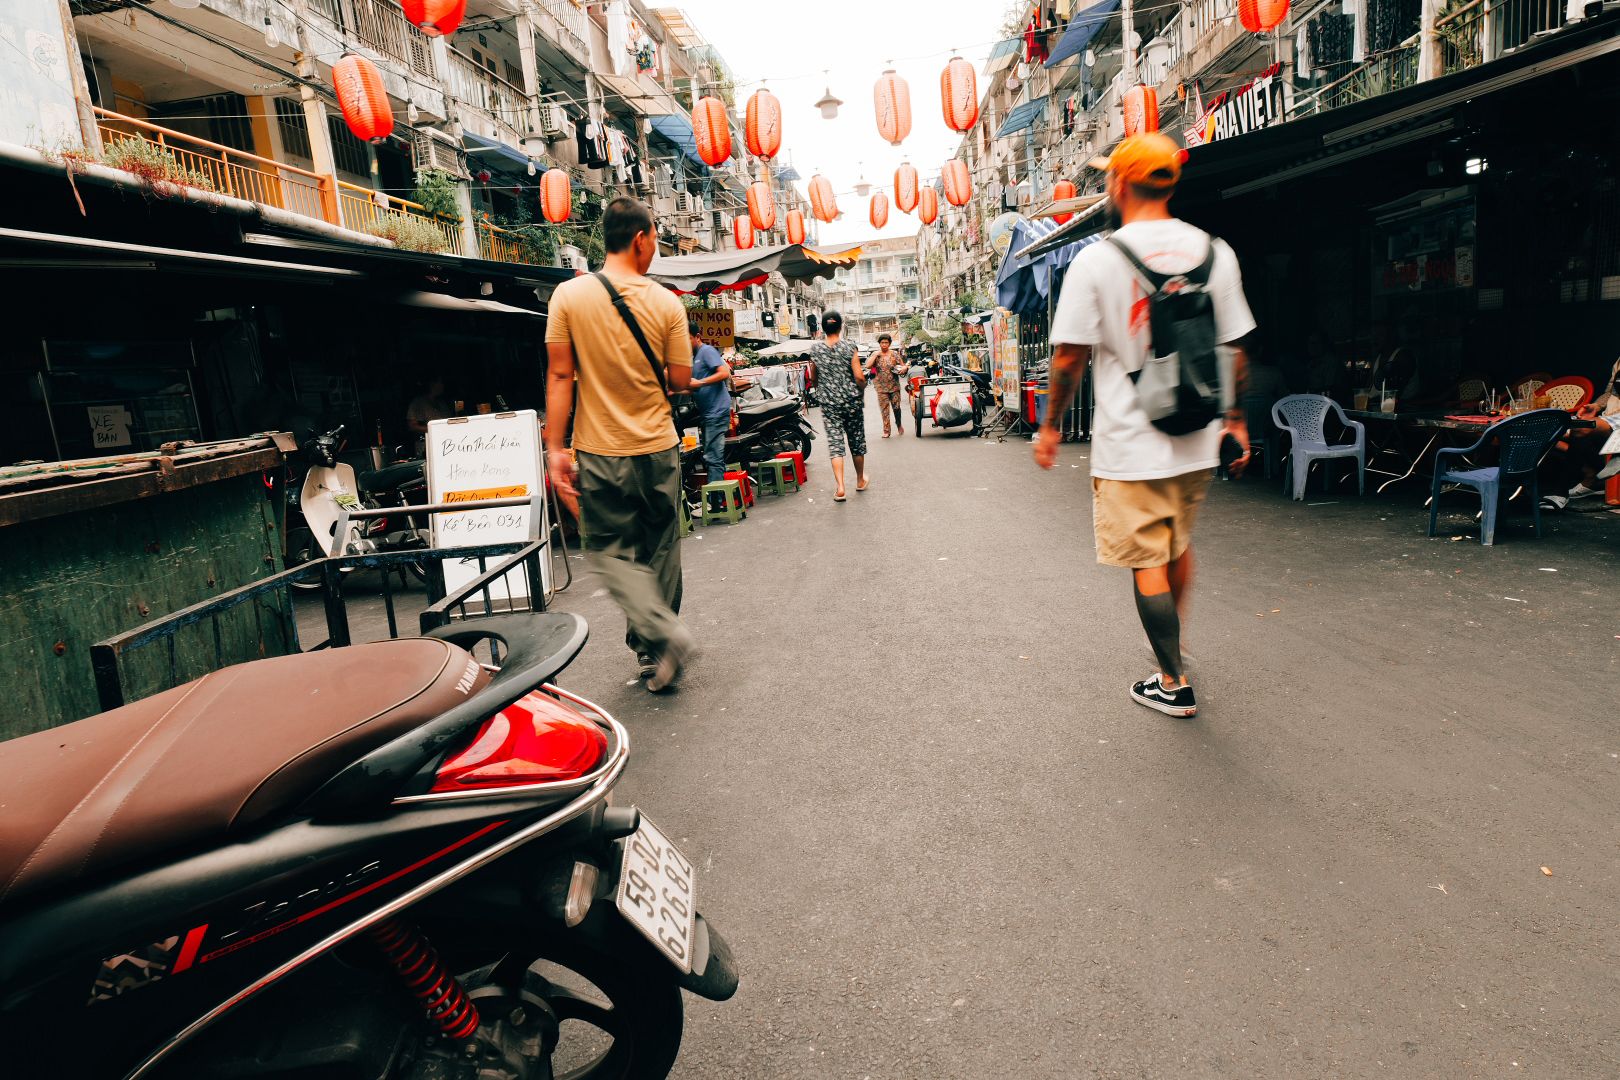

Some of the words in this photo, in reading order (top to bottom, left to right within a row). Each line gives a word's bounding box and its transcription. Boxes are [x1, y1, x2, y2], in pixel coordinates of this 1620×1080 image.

[1214, 100, 1239, 141] BIA
[1236, 75, 1273, 134] VIỆT
[707, 312, 731, 324] MỌC
[706, 326, 731, 338] GẠO
[92, 414, 115, 429] XE
[455, 659, 480, 695] YAMAH
[658, 847, 690, 959] 626.82
